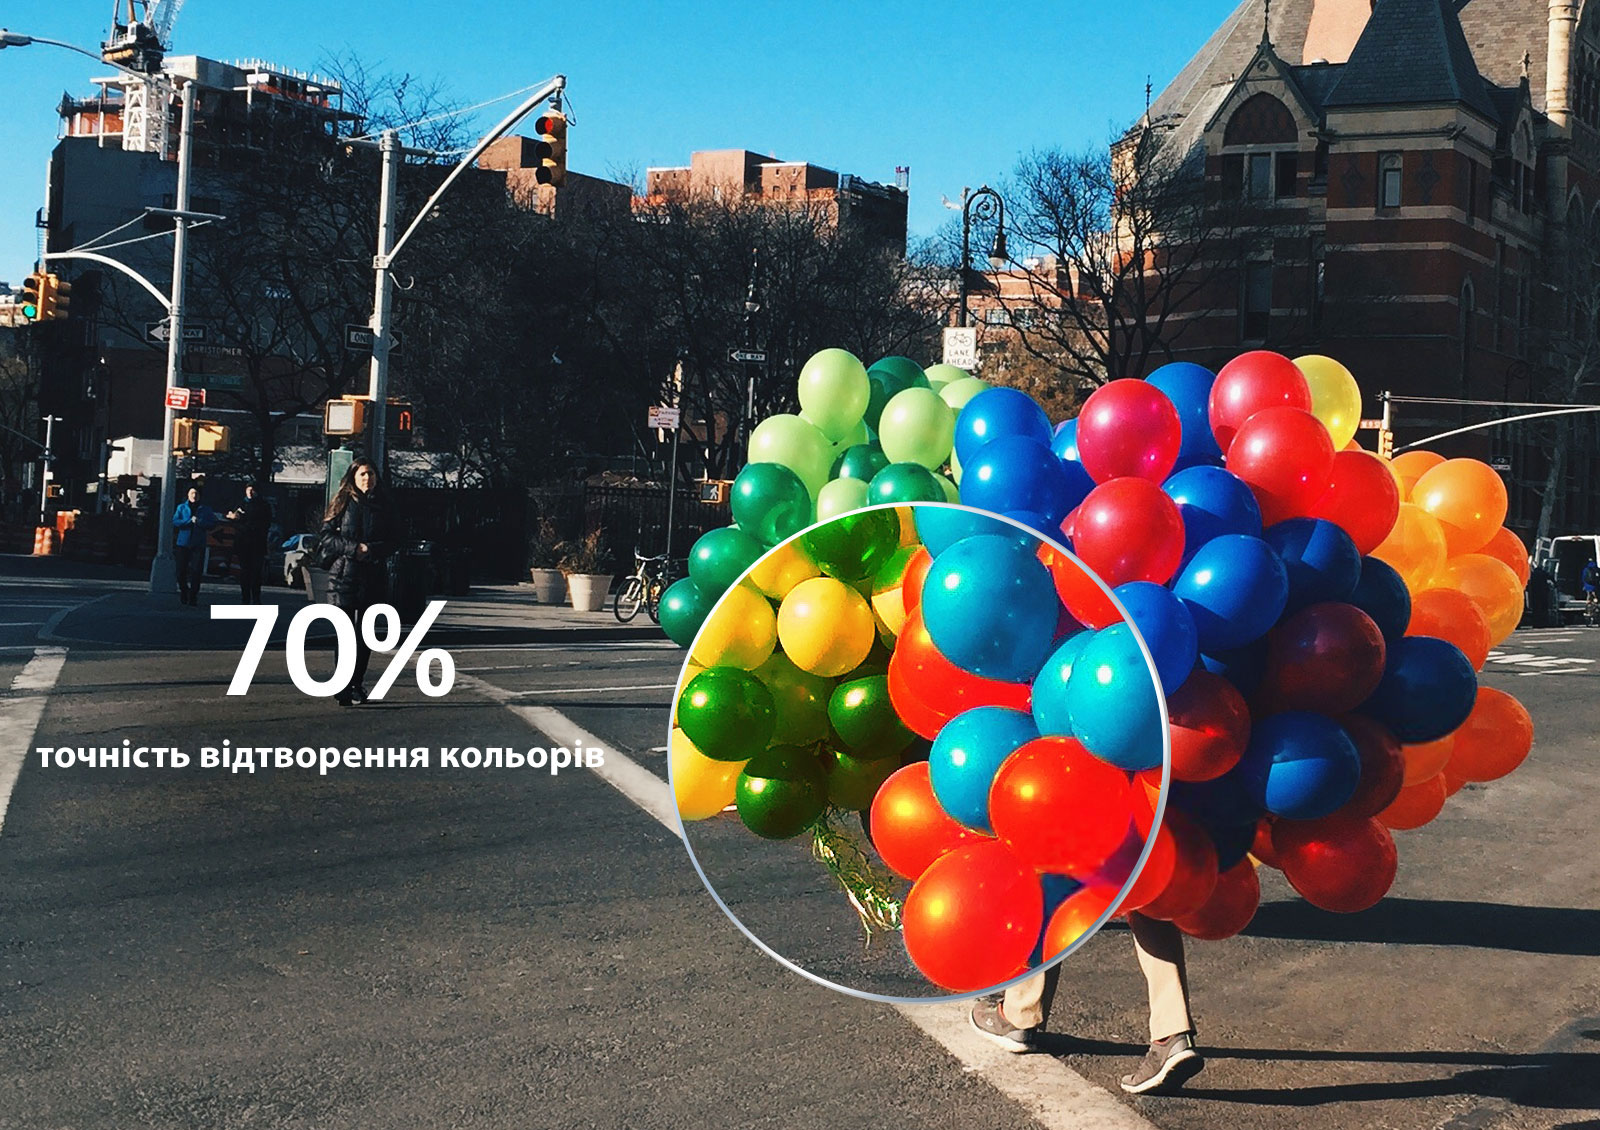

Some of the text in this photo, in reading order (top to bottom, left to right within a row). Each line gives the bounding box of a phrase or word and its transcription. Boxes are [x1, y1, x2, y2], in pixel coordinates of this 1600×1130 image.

[188, 344, 243, 357] CHRISTOPHER
[948, 349, 970, 357] LANE
[946, 357, 973, 366] AHEAD
